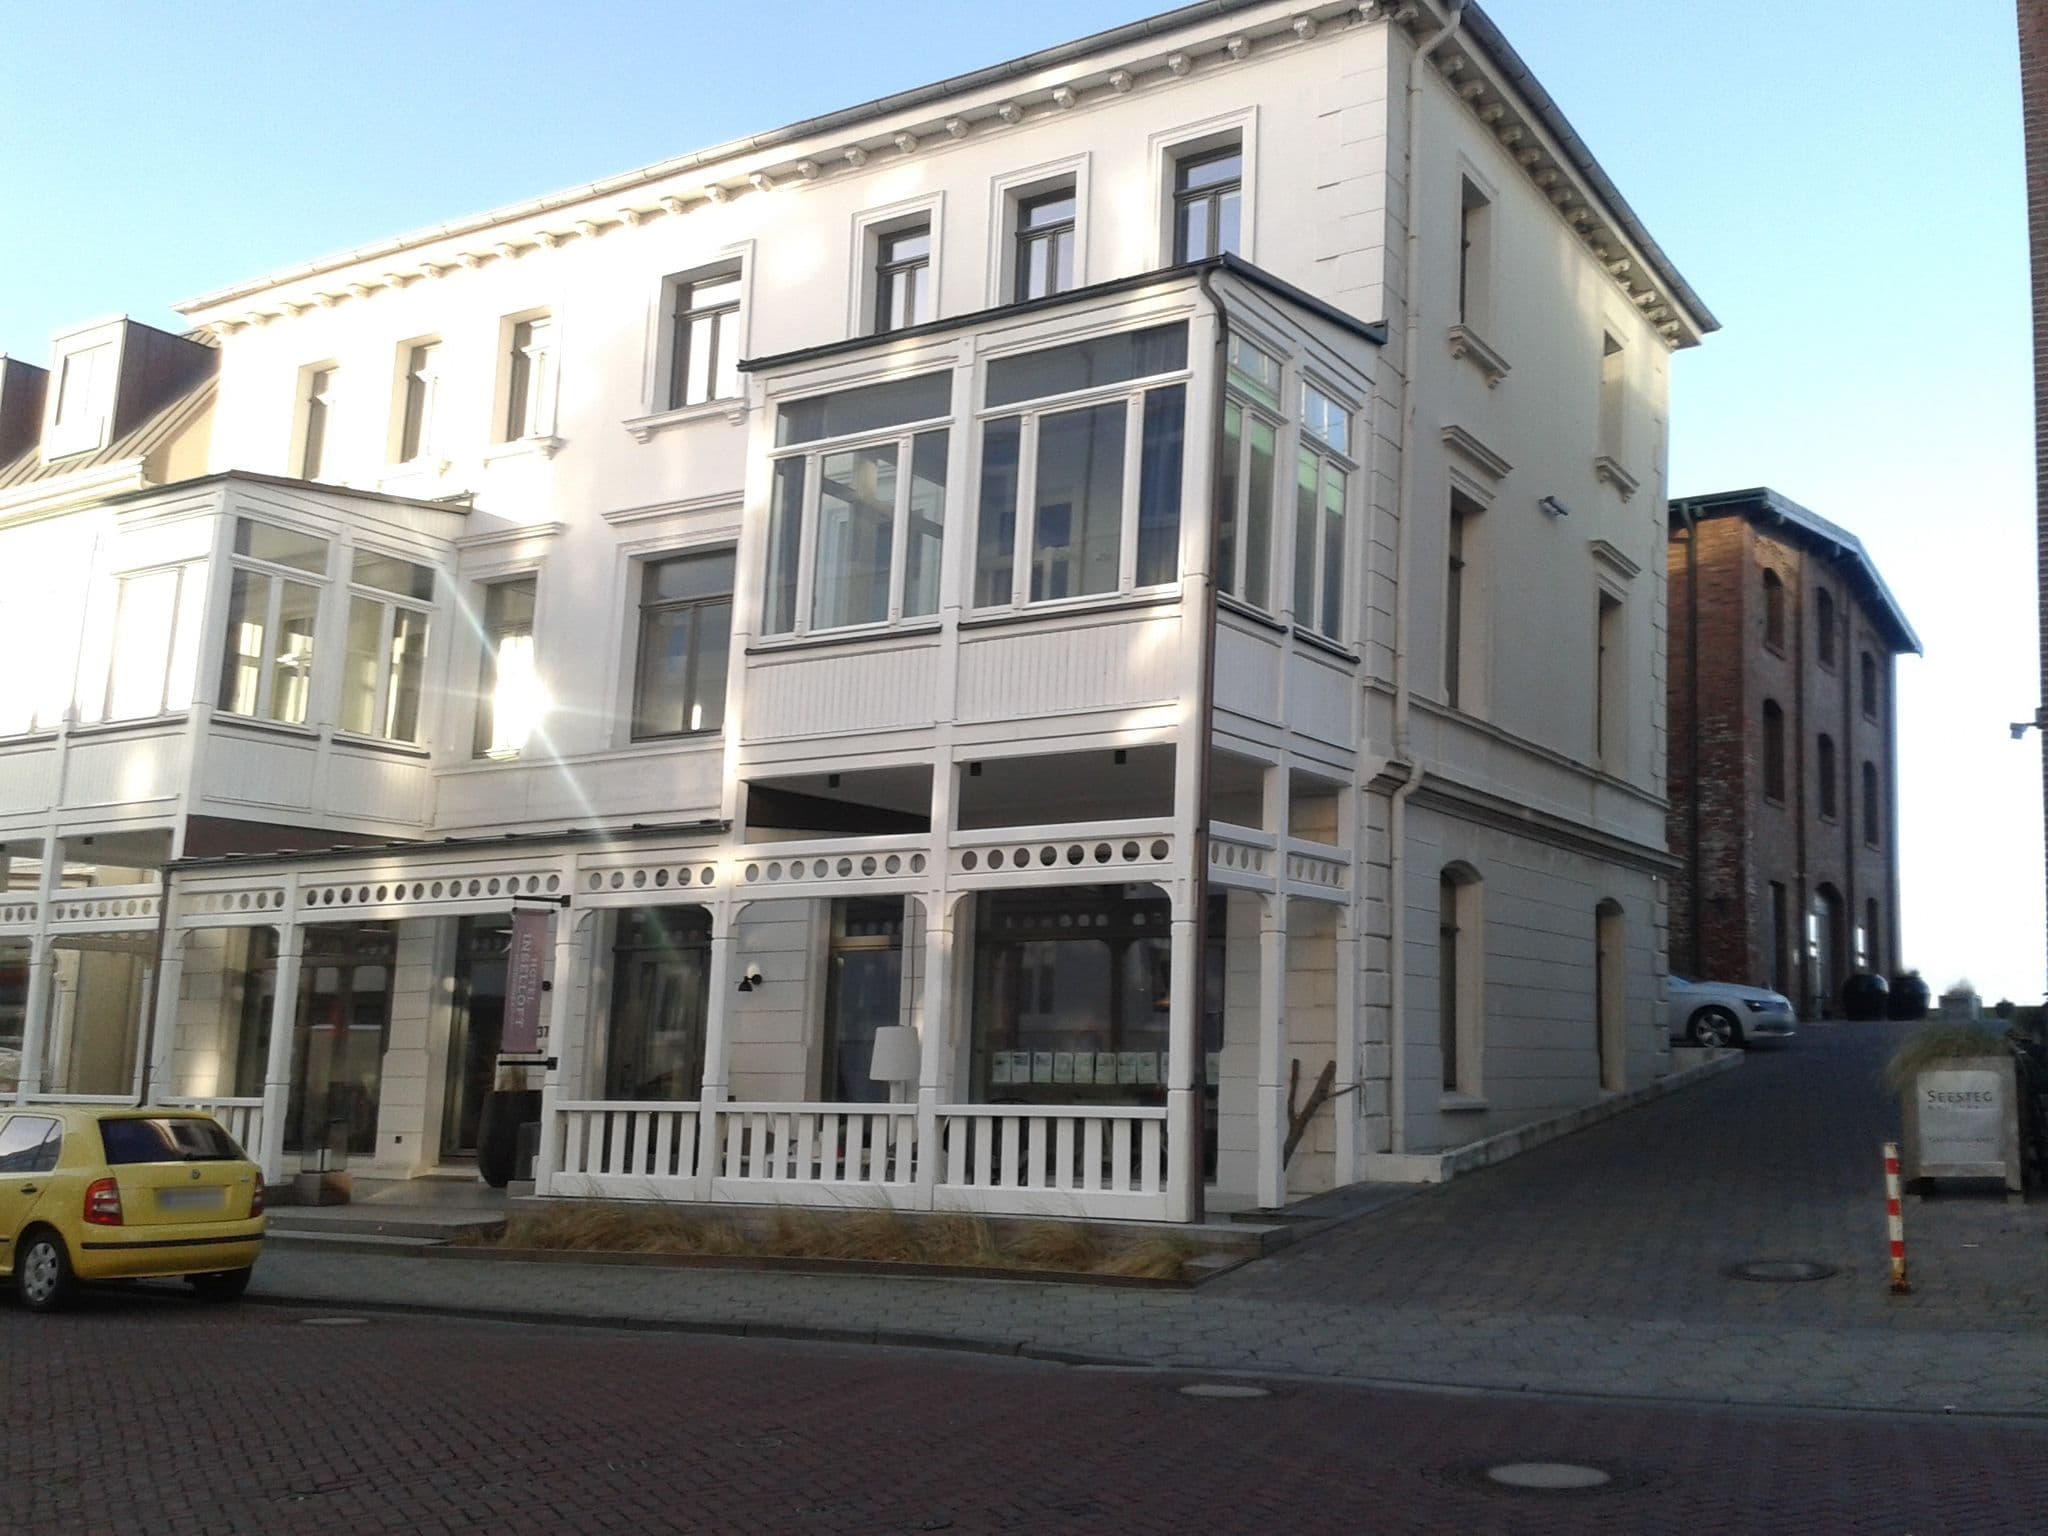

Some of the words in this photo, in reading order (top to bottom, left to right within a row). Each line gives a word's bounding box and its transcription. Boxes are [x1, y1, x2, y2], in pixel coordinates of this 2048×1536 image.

[515, 933, 532, 1028] INSELLOFT
[527, 957, 538, 1002] HOTEL
[1927, 1090, 1993, 1103] SEESTEG
